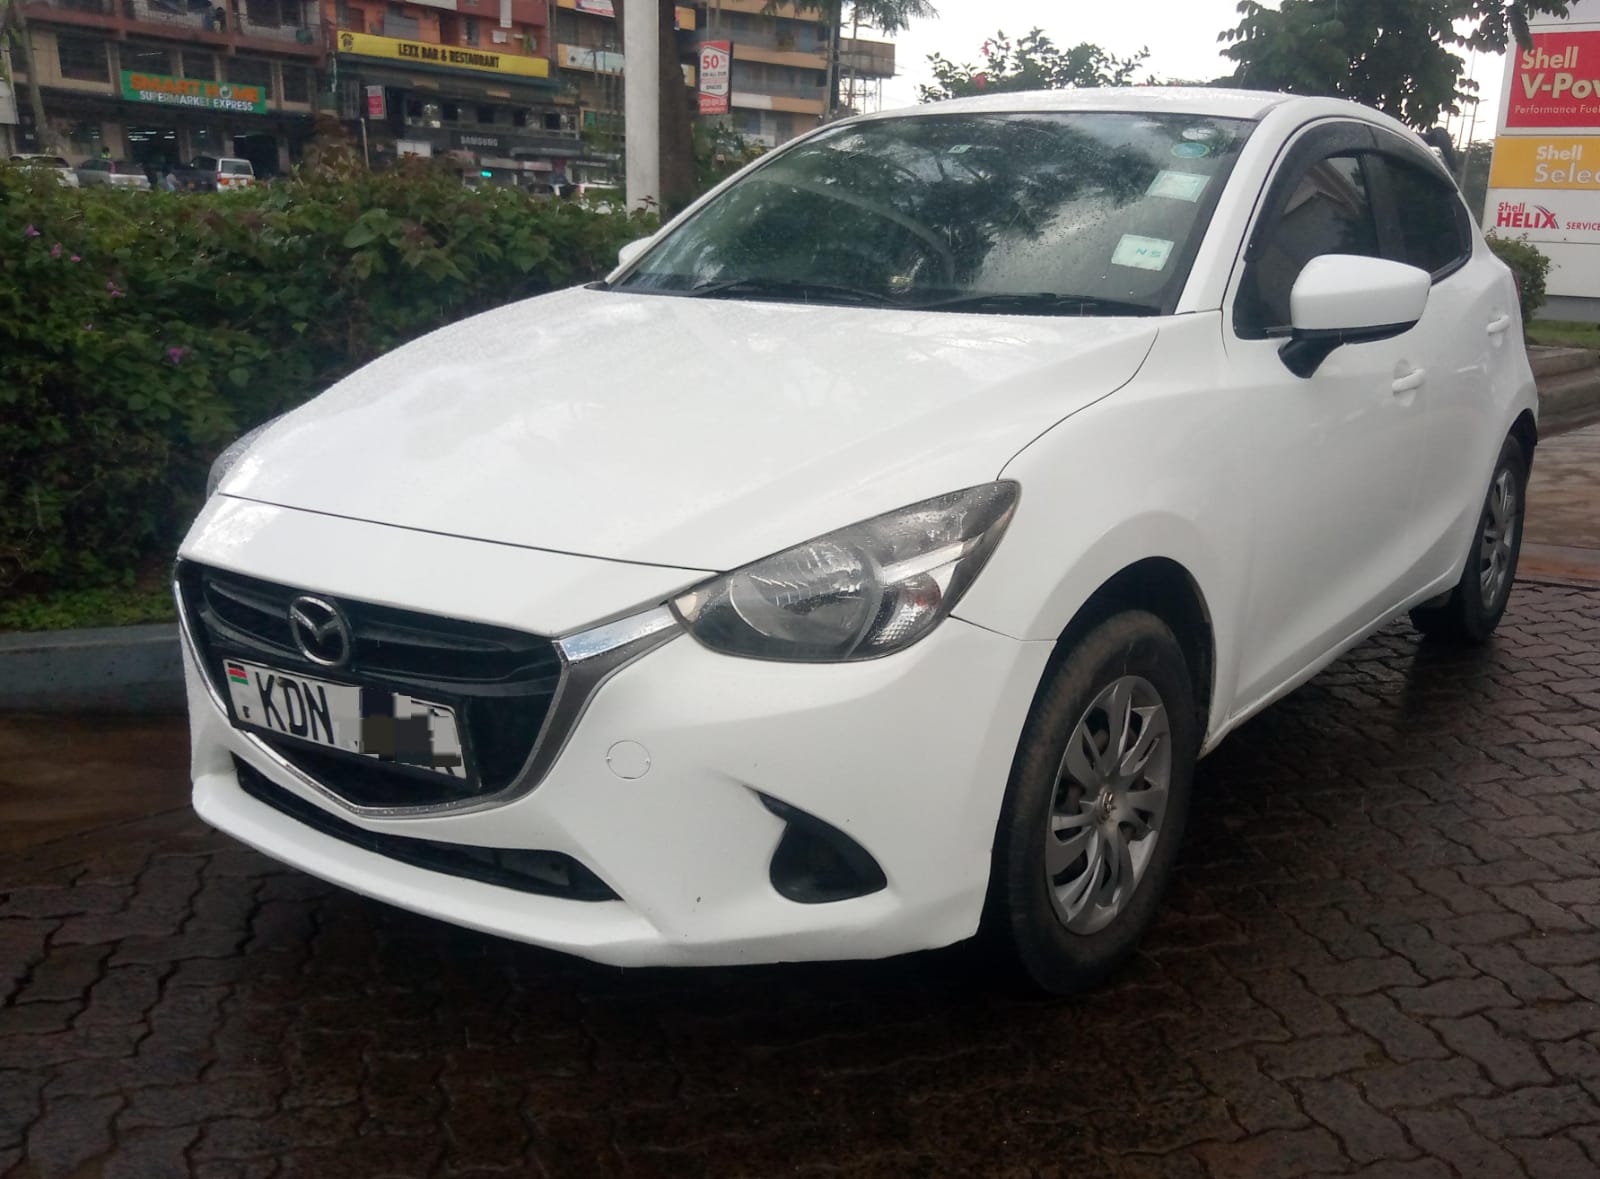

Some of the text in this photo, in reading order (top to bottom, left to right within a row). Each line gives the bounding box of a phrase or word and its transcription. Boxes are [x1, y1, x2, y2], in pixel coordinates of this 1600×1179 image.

[421, 46, 440, 60] BAR
[441, 49, 447, 61] &
[449, 50, 500, 69] RESTAURANT
[702, 55, 719, 70] 50
[1521, 46, 1579, 69] Shell
[131, 73, 259, 103] SMART HOME
[140, 90, 254, 111] SUPERMARKET EXPRESS
[1514, 104, 1577, 114] Performance
[460, 135, 498, 147] SAMSUNG
[1536, 144, 1583, 160] Shell
[1498, 202, 1526, 212] Shell
[1497, 208, 1558, 229] HELIX
[255, 671, 335, 745] KDN
